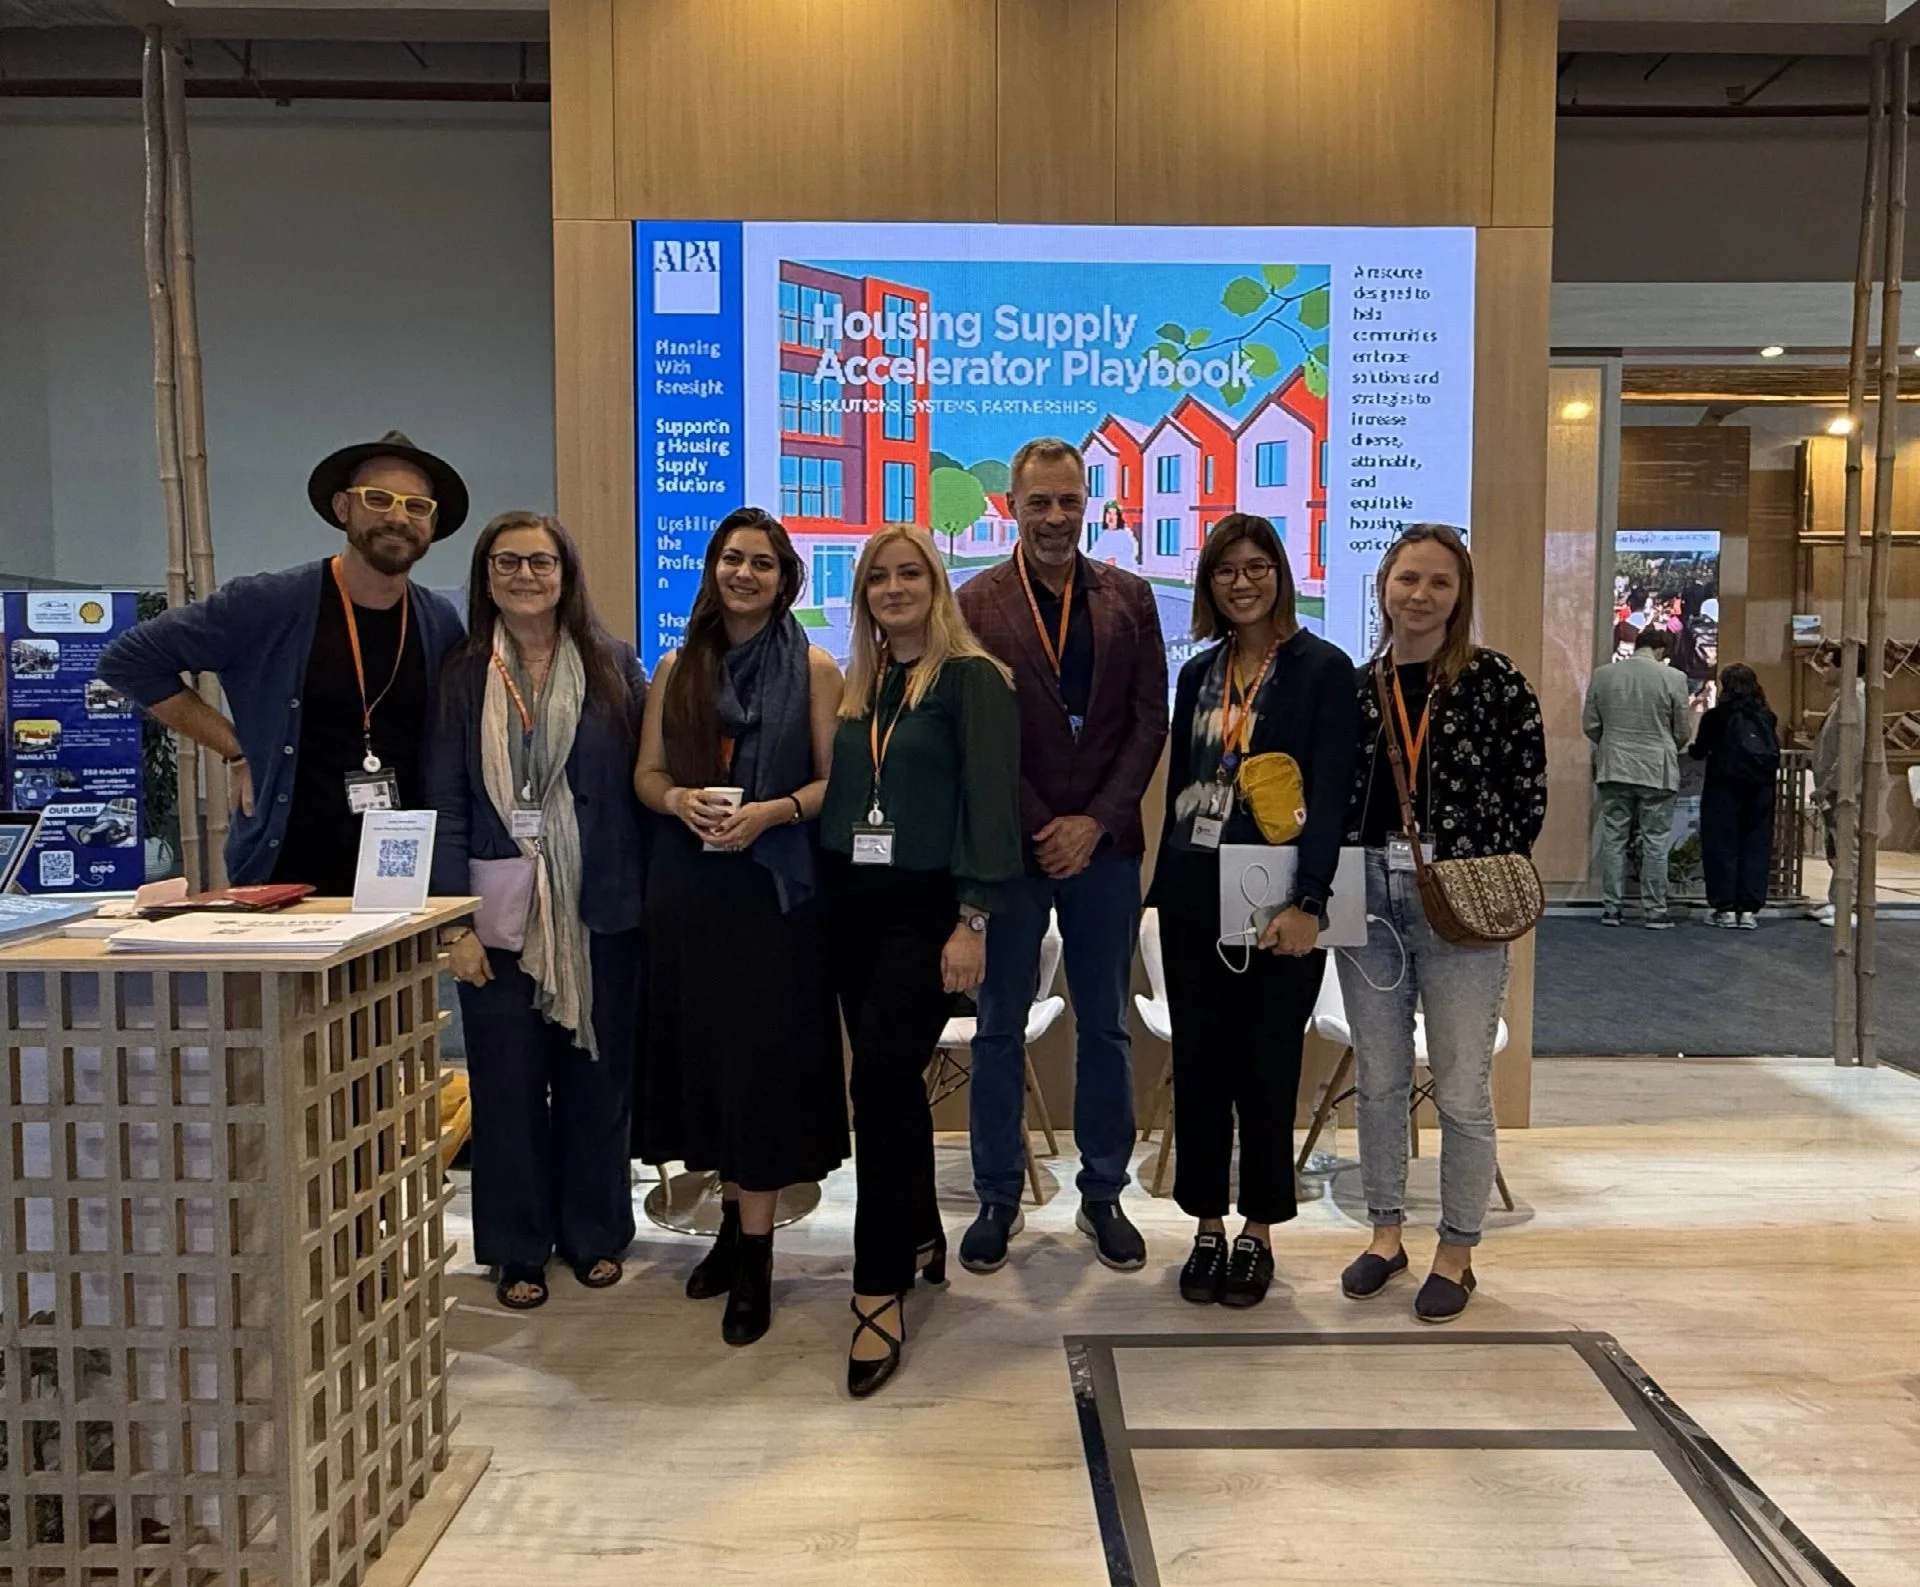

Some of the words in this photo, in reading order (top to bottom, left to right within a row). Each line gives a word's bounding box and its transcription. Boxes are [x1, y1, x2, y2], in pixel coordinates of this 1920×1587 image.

[1415, 287, 1431, 300] to
[813, 303, 981, 348] Housing
[994, 304, 1138, 349] Supply
[655, 339, 721, 359] Planning
[655, 359, 691, 374] With
[812, 348, 1051, 386] Accelerator
[1063, 350, 1255, 394] Playbook
[1413, 370, 1440, 384] and
[656, 378, 724, 398] Foresight
[1416, 393, 1431, 404] to
[982, 400, 1098, 414] PARTNERSHIPS
[668, 438, 730, 456] Housing
[656, 457, 708, 476] Supply
[657, 477, 725, 493] Solutions
[1351, 475, 1376, 488] and
[657, 535, 682, 550] the
[658, 554, 705, 570] Profes
[71, 806, 98, 814] CARS
